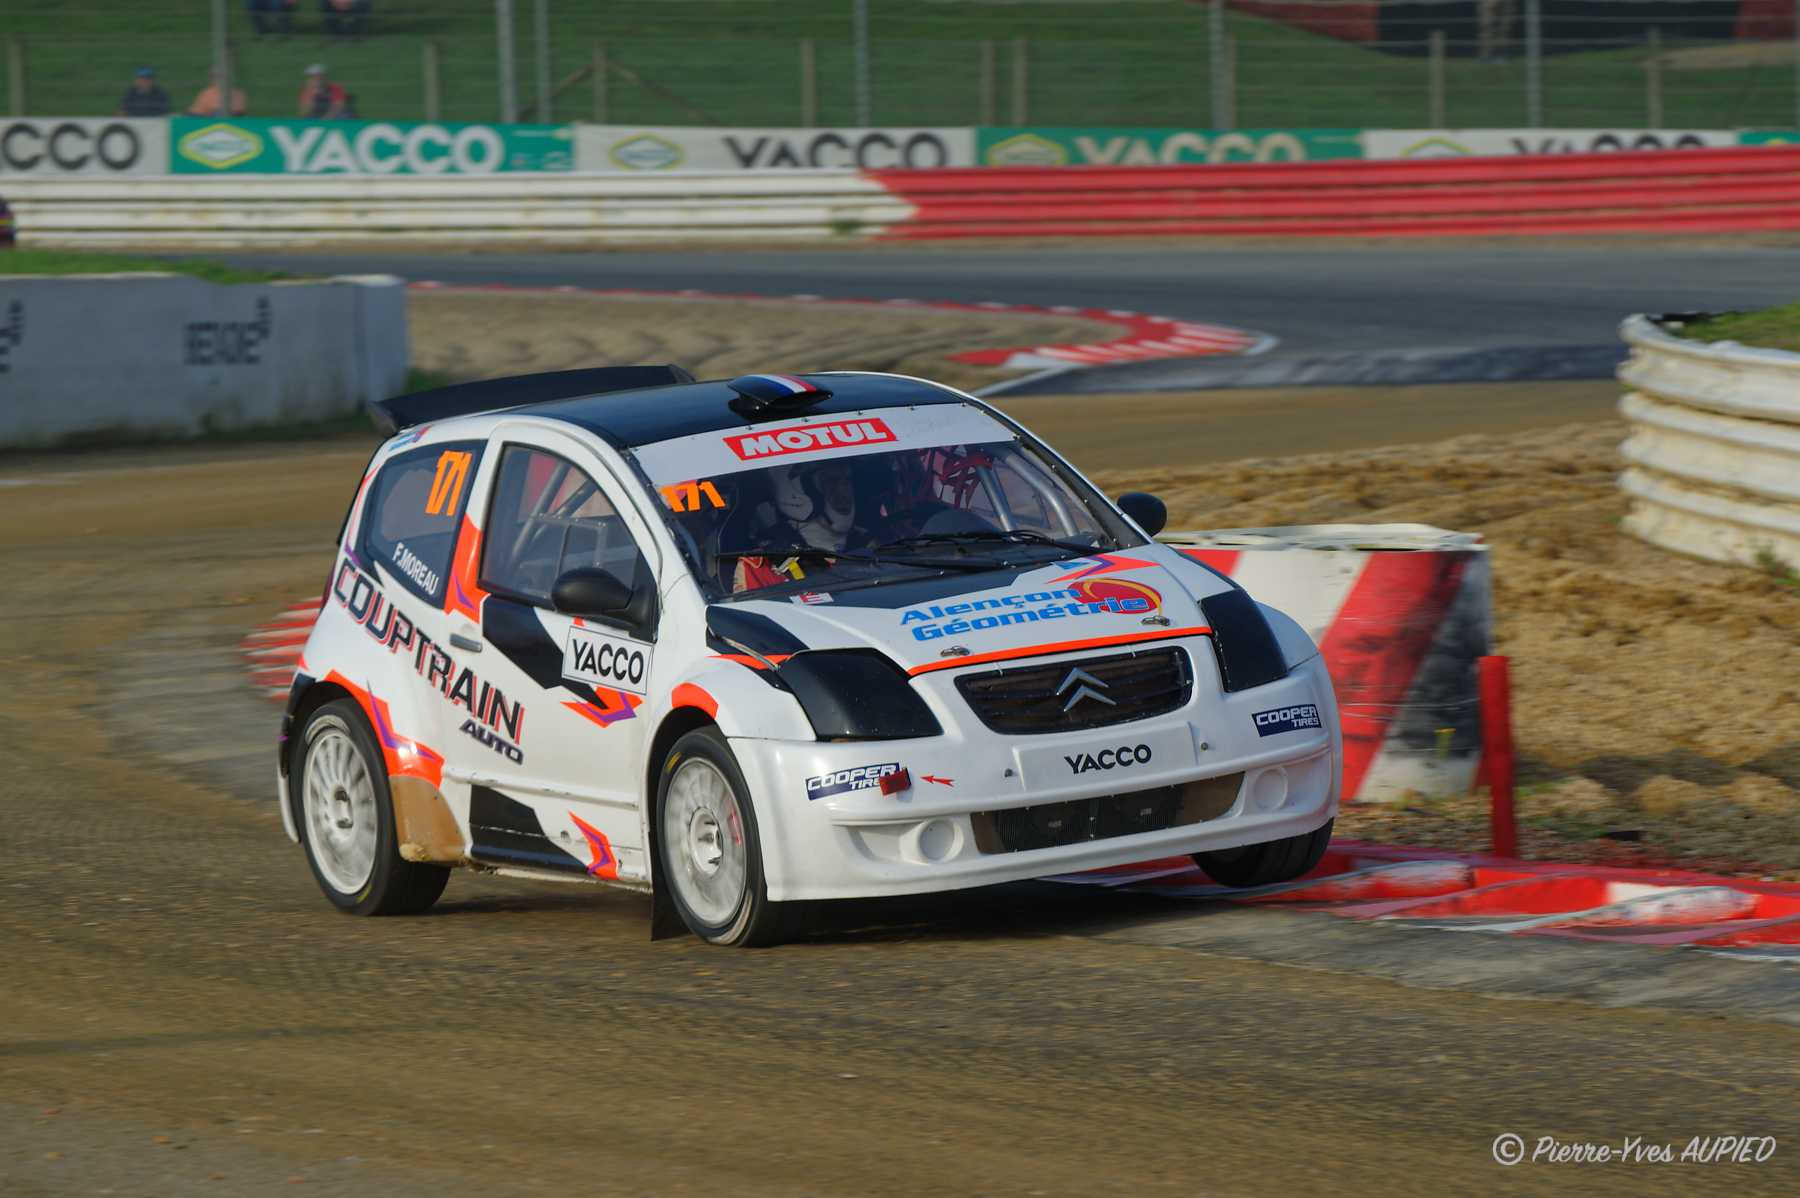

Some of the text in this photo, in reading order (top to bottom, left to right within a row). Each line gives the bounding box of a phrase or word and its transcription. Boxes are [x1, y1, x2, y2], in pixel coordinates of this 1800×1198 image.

[0, 122, 142, 171] CCO
[269, 123, 503, 172] YACCO
[722, 133, 947, 168] YACCO
[743, 420, 887, 457] MOTUL
[425, 450, 472, 516] 171
[656, 480, 726, 512] 171
[392, 542, 439, 595] F.MOREAU
[901, 588, 1082, 625] Alençon
[912, 596, 1150, 641] Géométrie
[334, 558, 524, 745] COUPTRAIN
[573, 638, 644, 685] YACCO
[1256, 706, 1317, 725] COOPER
[1291, 717, 1319, 727] TIRES
[459, 719, 524, 765] AUTO
[1064, 744, 1152, 775] YACCO
[808, 765, 897, 791] COOPER
[849, 777, 880, 790] TIRE
